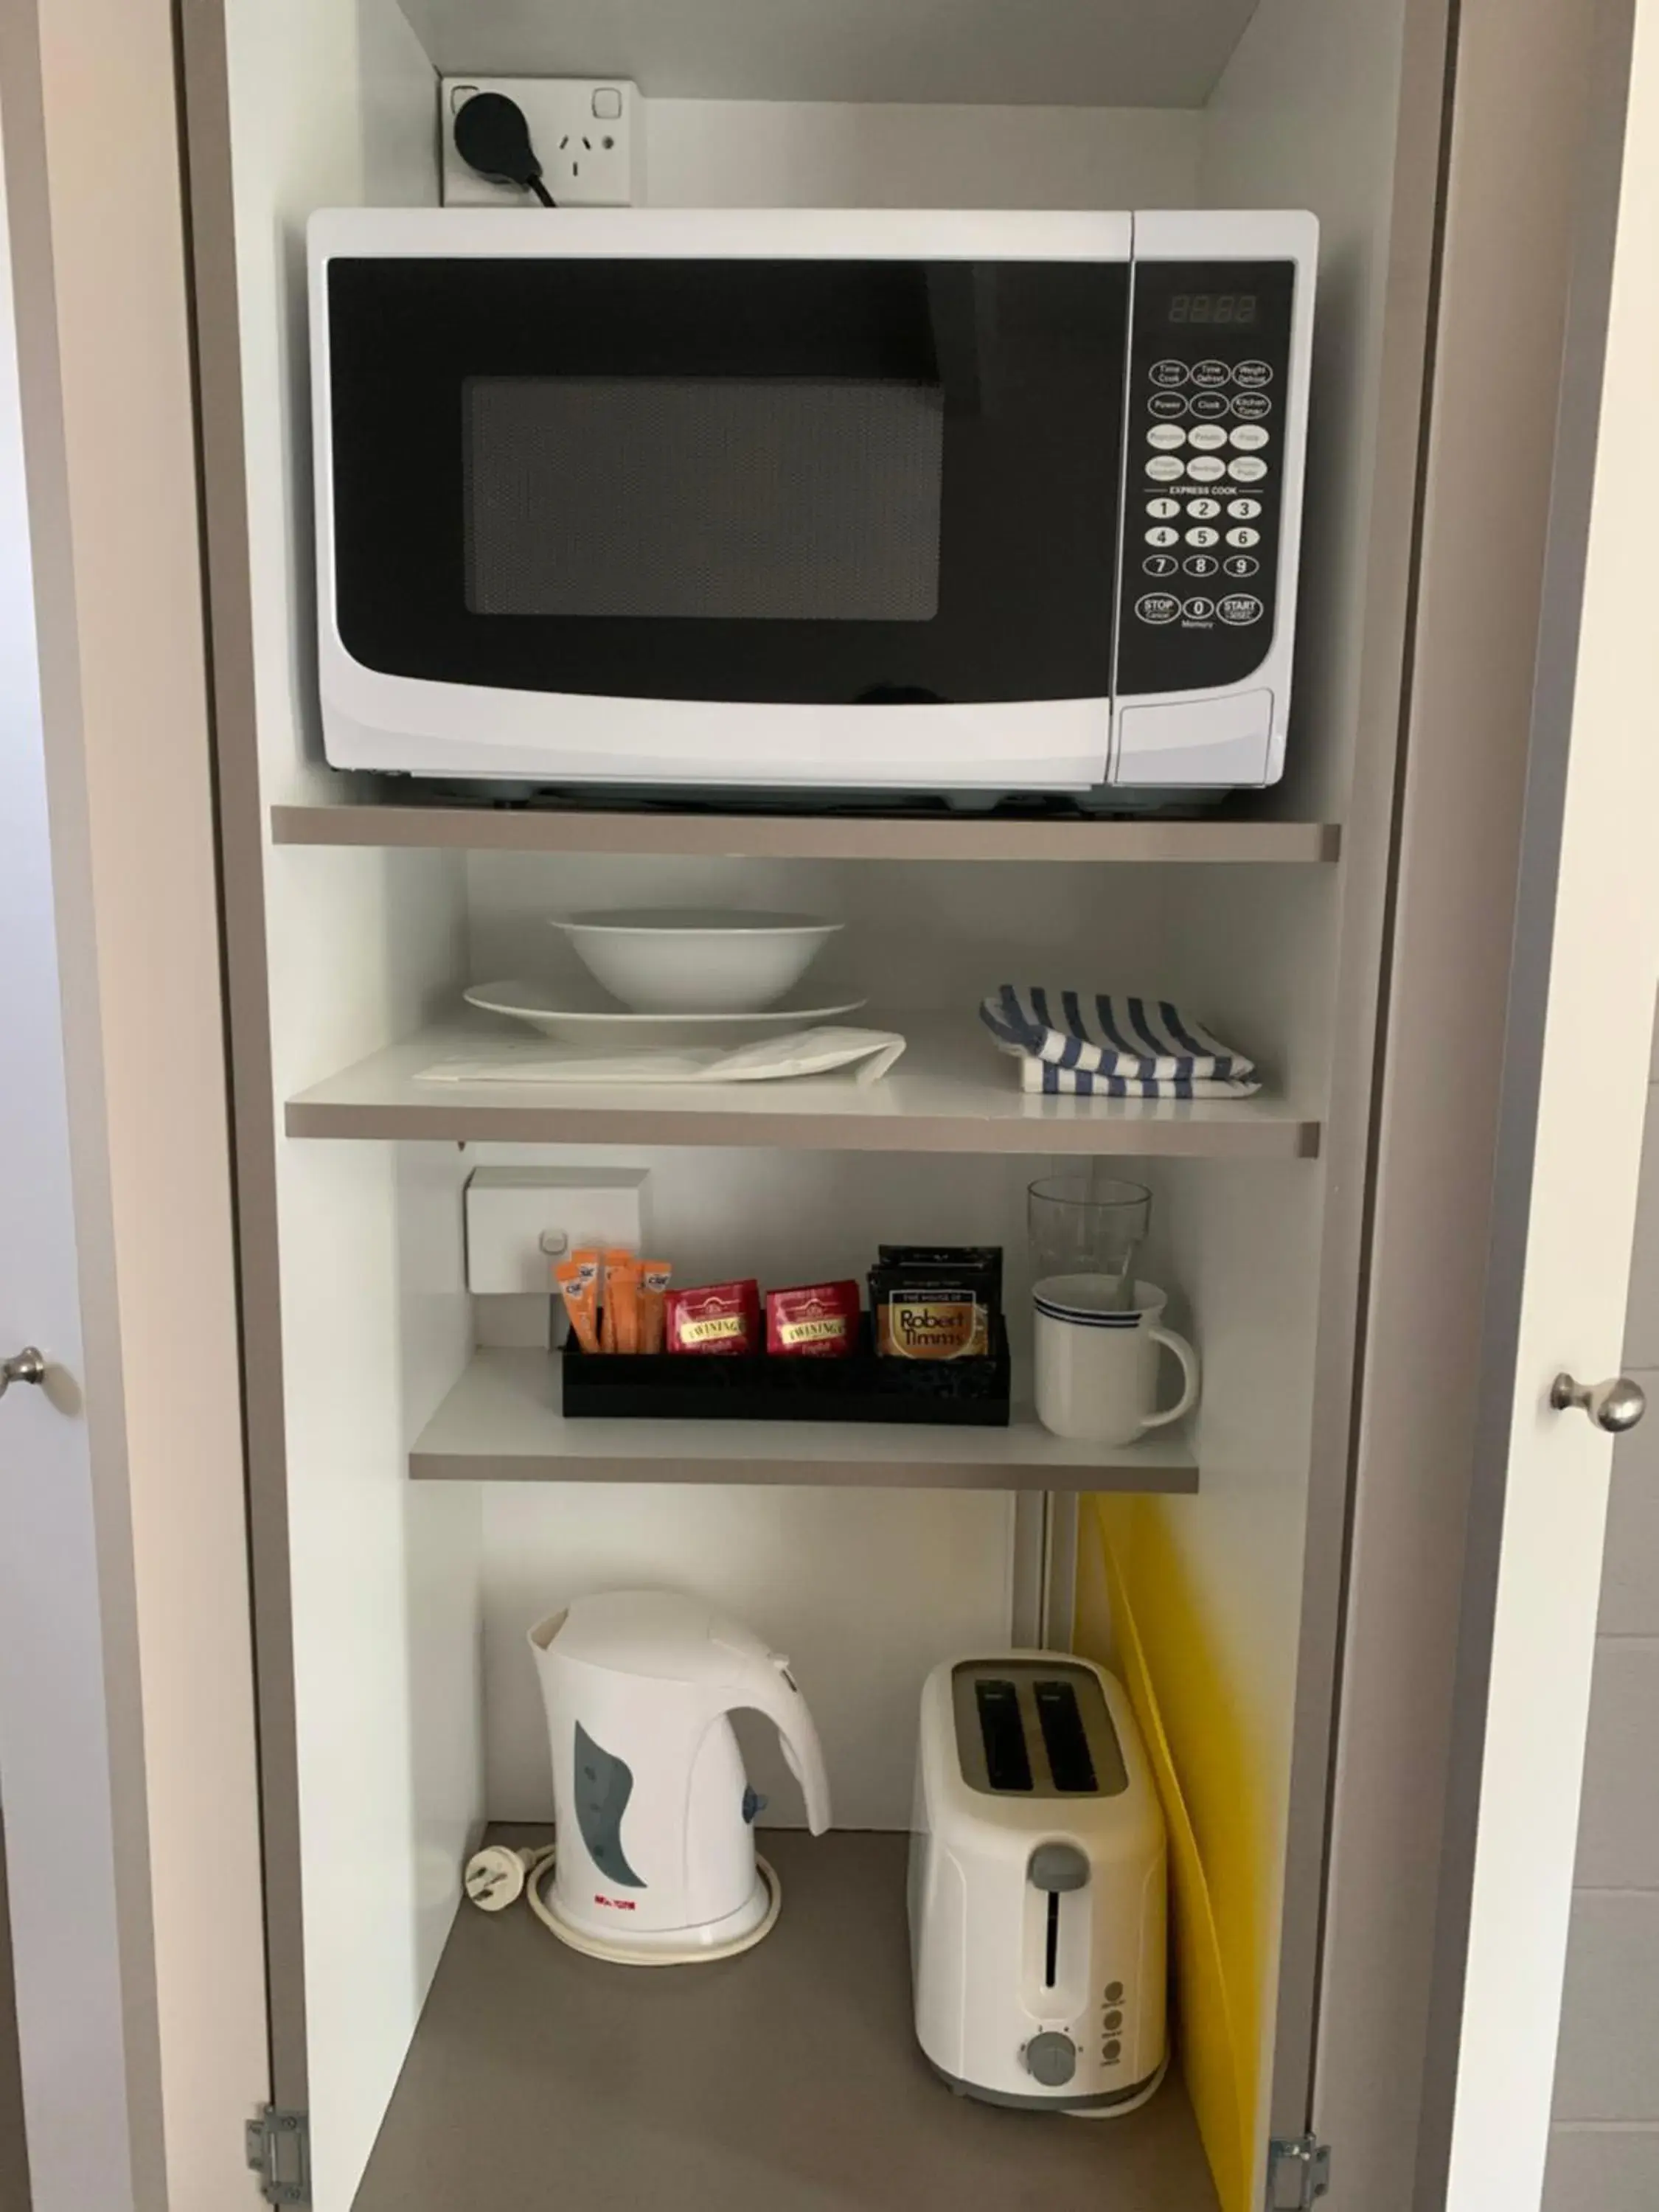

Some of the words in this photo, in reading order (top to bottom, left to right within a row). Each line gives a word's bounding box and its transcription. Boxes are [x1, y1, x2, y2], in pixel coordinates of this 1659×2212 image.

[1169, 486, 1209, 495] EXPRESS
[1211, 487, 1237, 495] COOK
[1160, 502, 1167, 515] 1
[1198, 502, 1209, 515] 2
[1240, 502, 1250, 516] 3
[1156, 531, 1166, 543] 4
[1197, 531, 1208, 544] 5
[1238, 531, 1248, 544] 6
[1155, 558, 1166, 573] 7
[1195, 558, 1206, 573] 8
[1236, 559, 1247, 574] 9
[1144, 599, 1174, 611] STOP
[1193, 601, 1204, 615] 0
[1224, 600, 1256, 611] START
[900, 1308, 964, 1328] Robert
[905, 1329, 964, 1346] Timms
